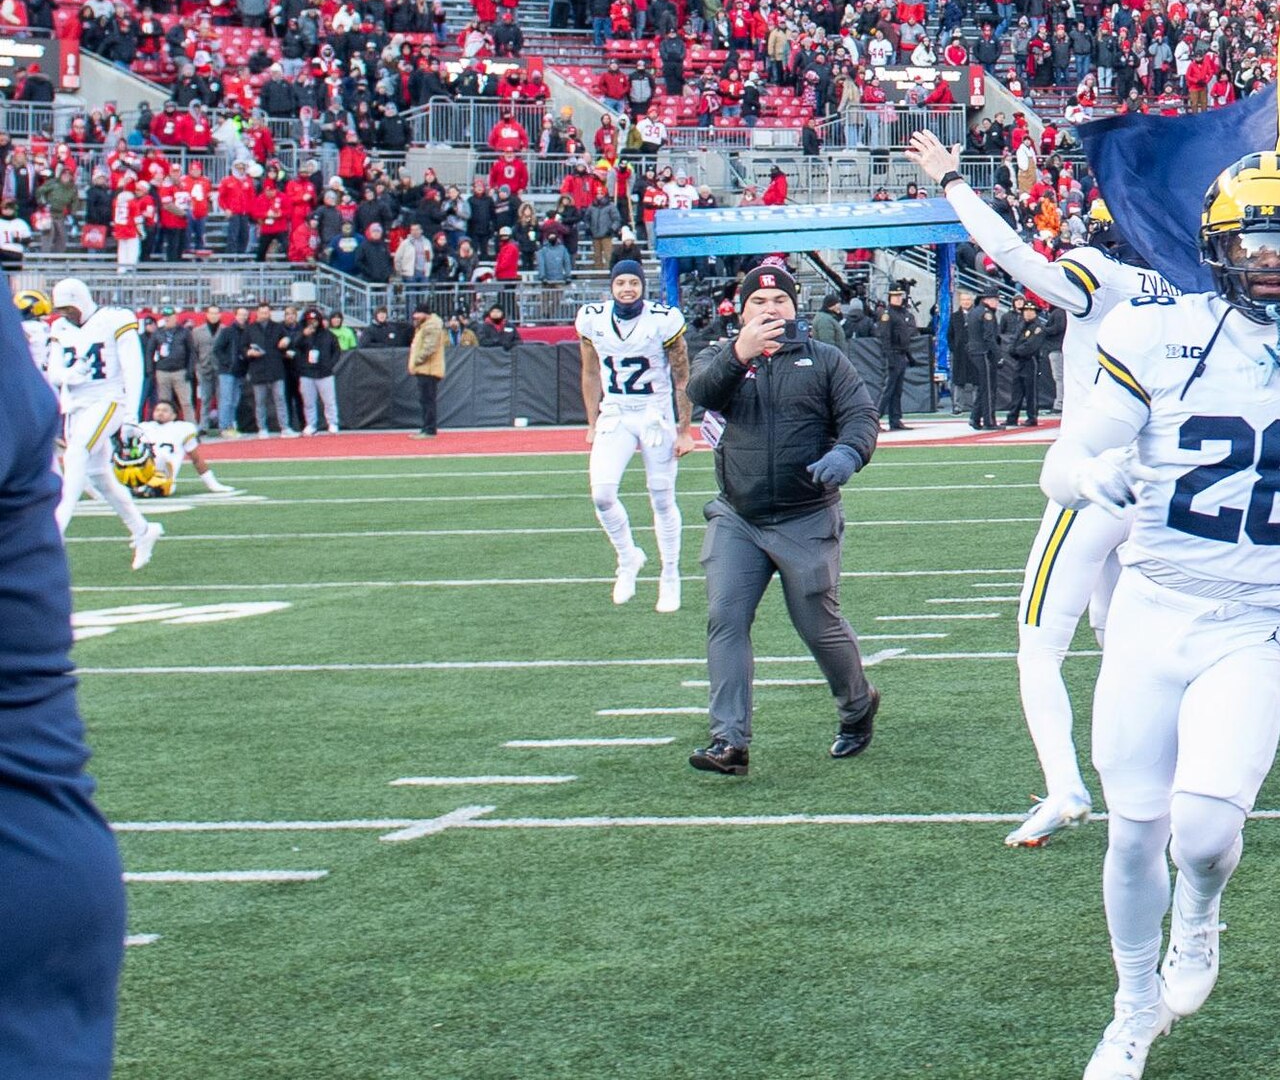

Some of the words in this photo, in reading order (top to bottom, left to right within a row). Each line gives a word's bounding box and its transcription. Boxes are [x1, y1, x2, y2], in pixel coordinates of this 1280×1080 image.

[644, 125, 660, 138] 34
[1260, 205, 1275, 215] M
[603, 356, 654, 395] 12
